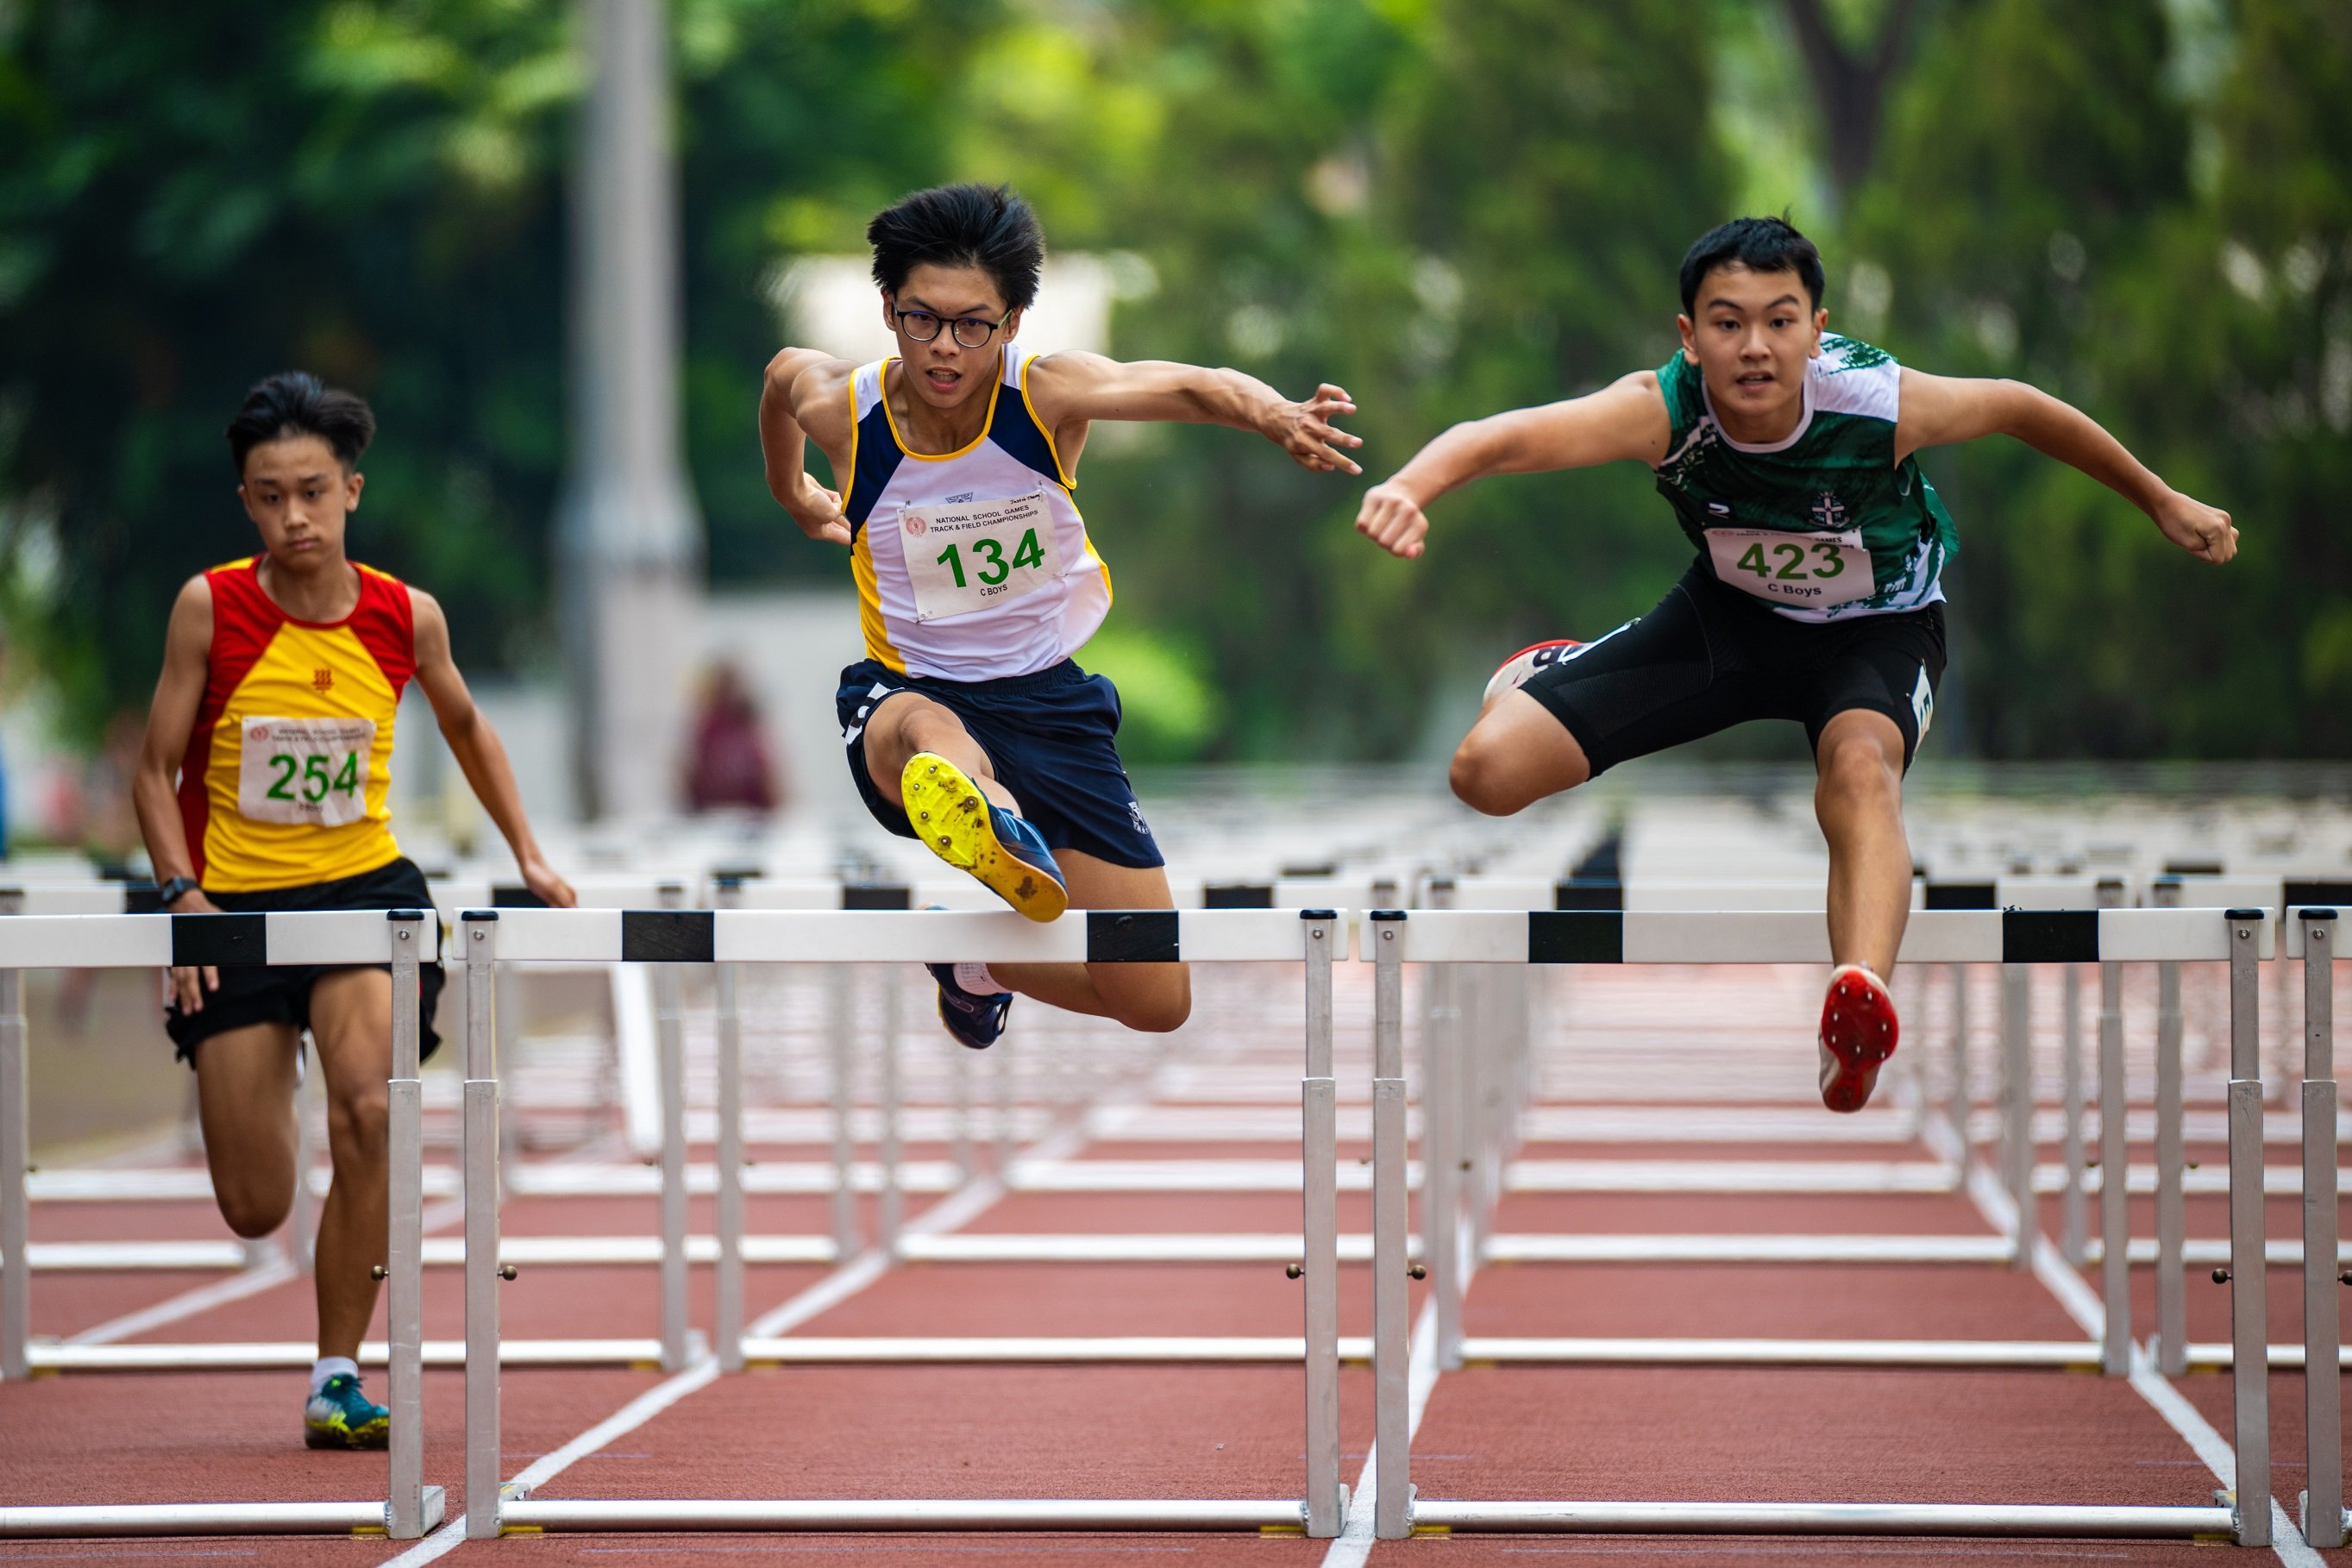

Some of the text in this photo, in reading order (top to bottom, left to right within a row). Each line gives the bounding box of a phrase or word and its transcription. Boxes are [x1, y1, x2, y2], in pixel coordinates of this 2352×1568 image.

[936, 505, 1029, 524] NATIONAL SCHOOL GAMES
[982, 510, 1038, 526] CHAMPIONSHIPS
[937, 528, 1045, 588] 134
[1737, 543, 1845, 580] 423
[987, 584, 1008, 596] BOYS
[1767, 583, 1822, 598] C Boys
[267, 750, 358, 802] 254
